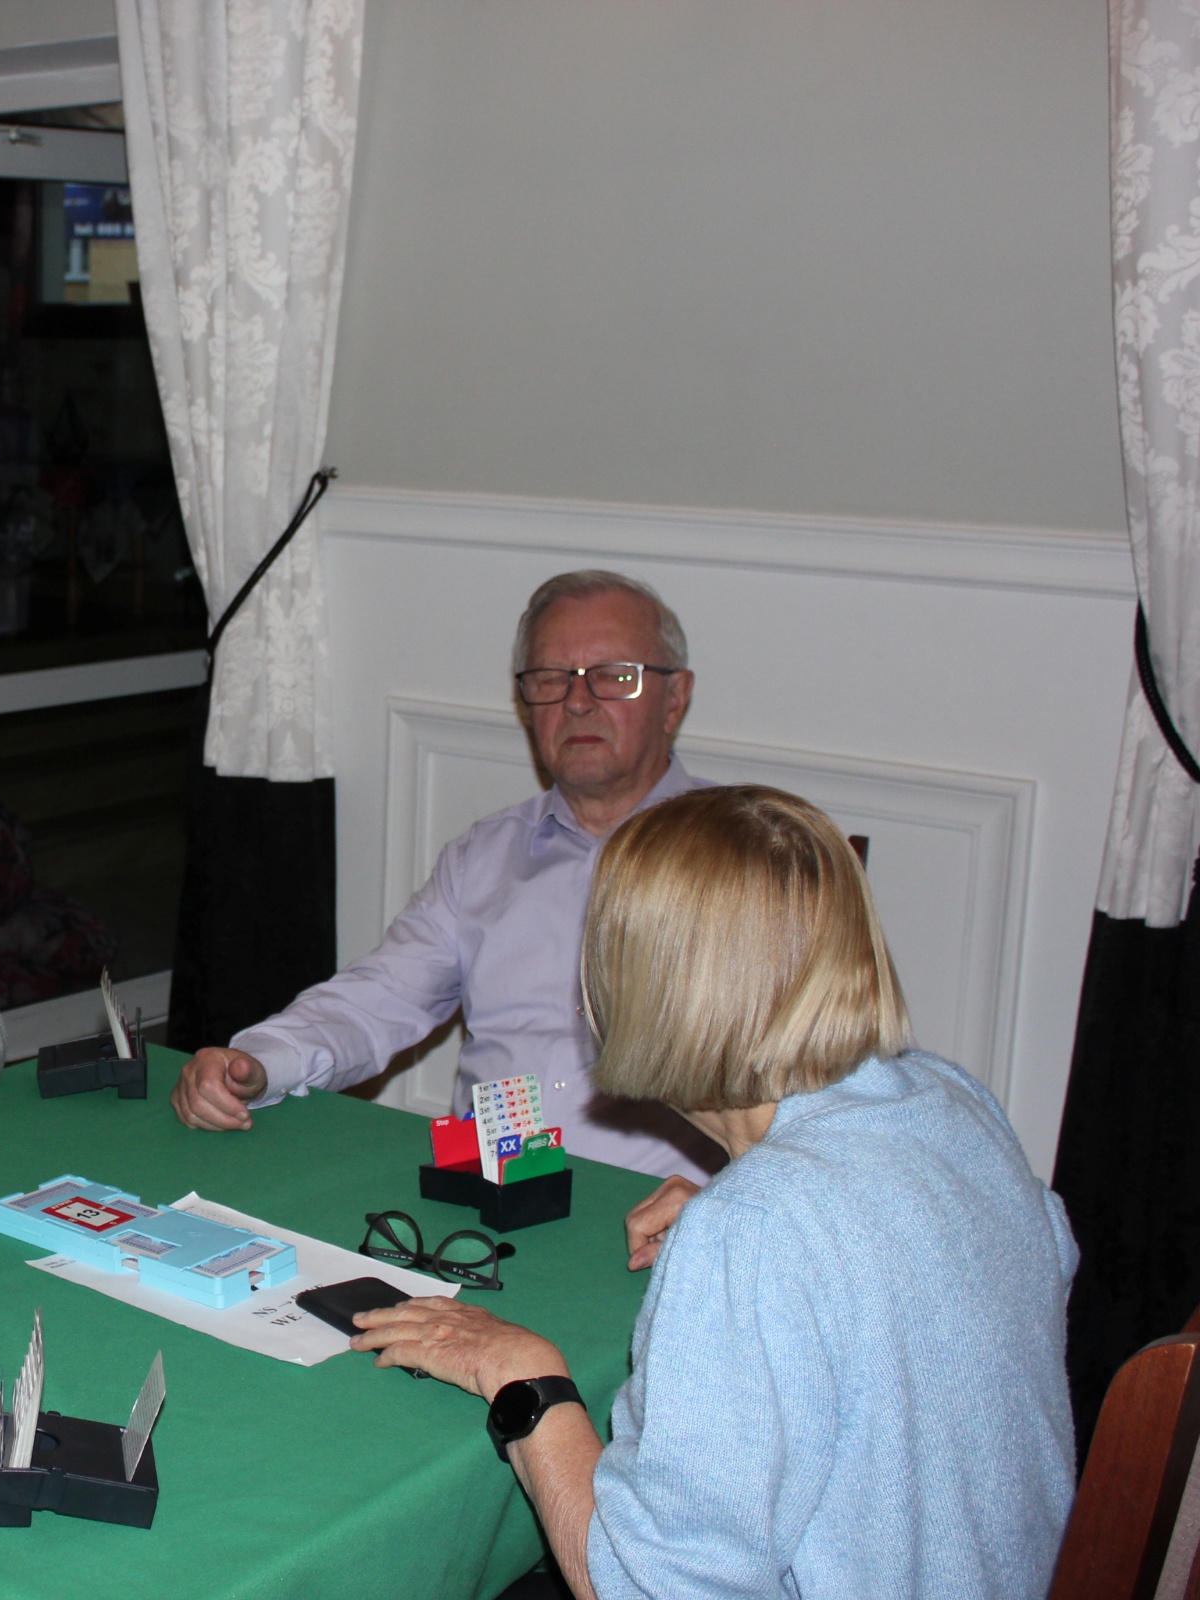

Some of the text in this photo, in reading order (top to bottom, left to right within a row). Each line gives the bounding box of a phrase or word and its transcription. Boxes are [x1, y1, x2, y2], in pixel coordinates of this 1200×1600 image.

[548, 1131, 558, 1146] X
[500, 1140, 516, 1153] XX
[77, 1210, 100, 1218] 13
[252, 1306, 278, 1318] NS
[270, 1314, 302, 1326] WE
